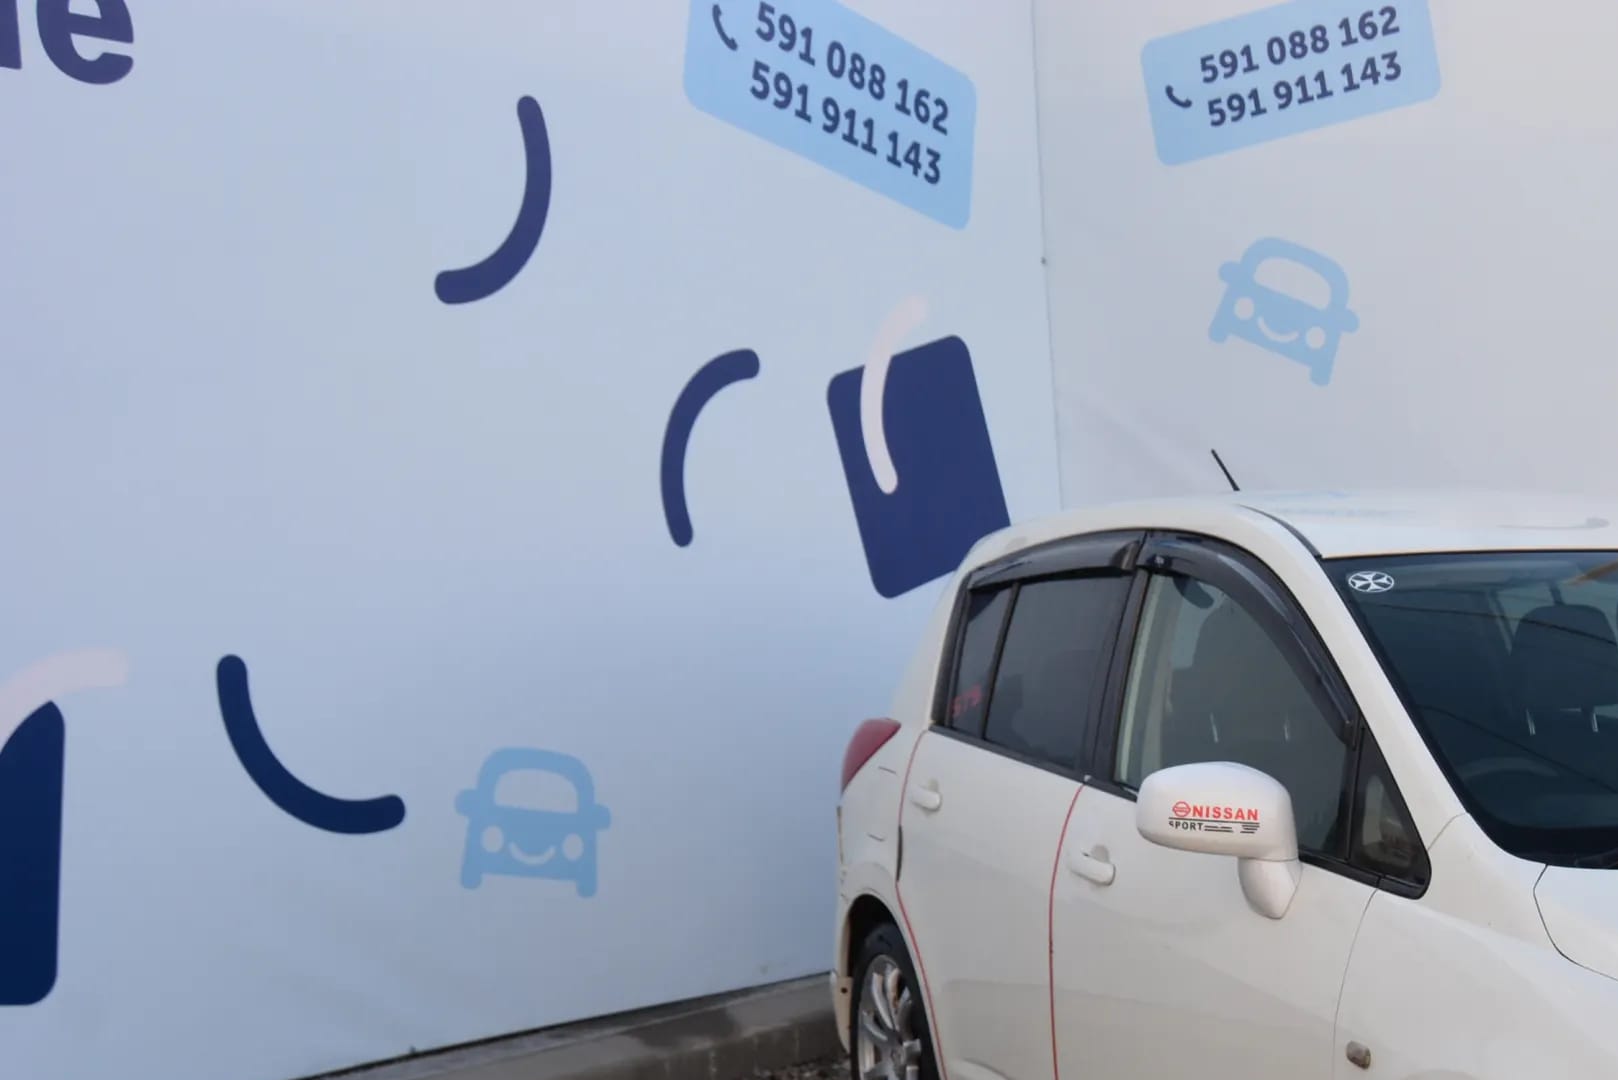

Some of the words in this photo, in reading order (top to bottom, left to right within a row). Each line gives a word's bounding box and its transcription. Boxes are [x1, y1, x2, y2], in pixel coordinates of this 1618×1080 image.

[755, 1, 816, 66] 591
[826, 40, 886, 101] 088
[895, 78, 949, 136] 162
[1200, 44, 1260, 83] 591
[1266, 25, 1330, 66] 088
[1338, 5, 1400, 47] 162
[750, 60, 812, 123] 591
[822, 97, 878, 156] 911
[886, 130, 941, 185] 143
[1207, 87, 1267, 127] 591
[1273, 70, 1334, 110] 911
[1340, 51, 1402, 92] 143
[1192, 805, 1258, 821] NISSAN
